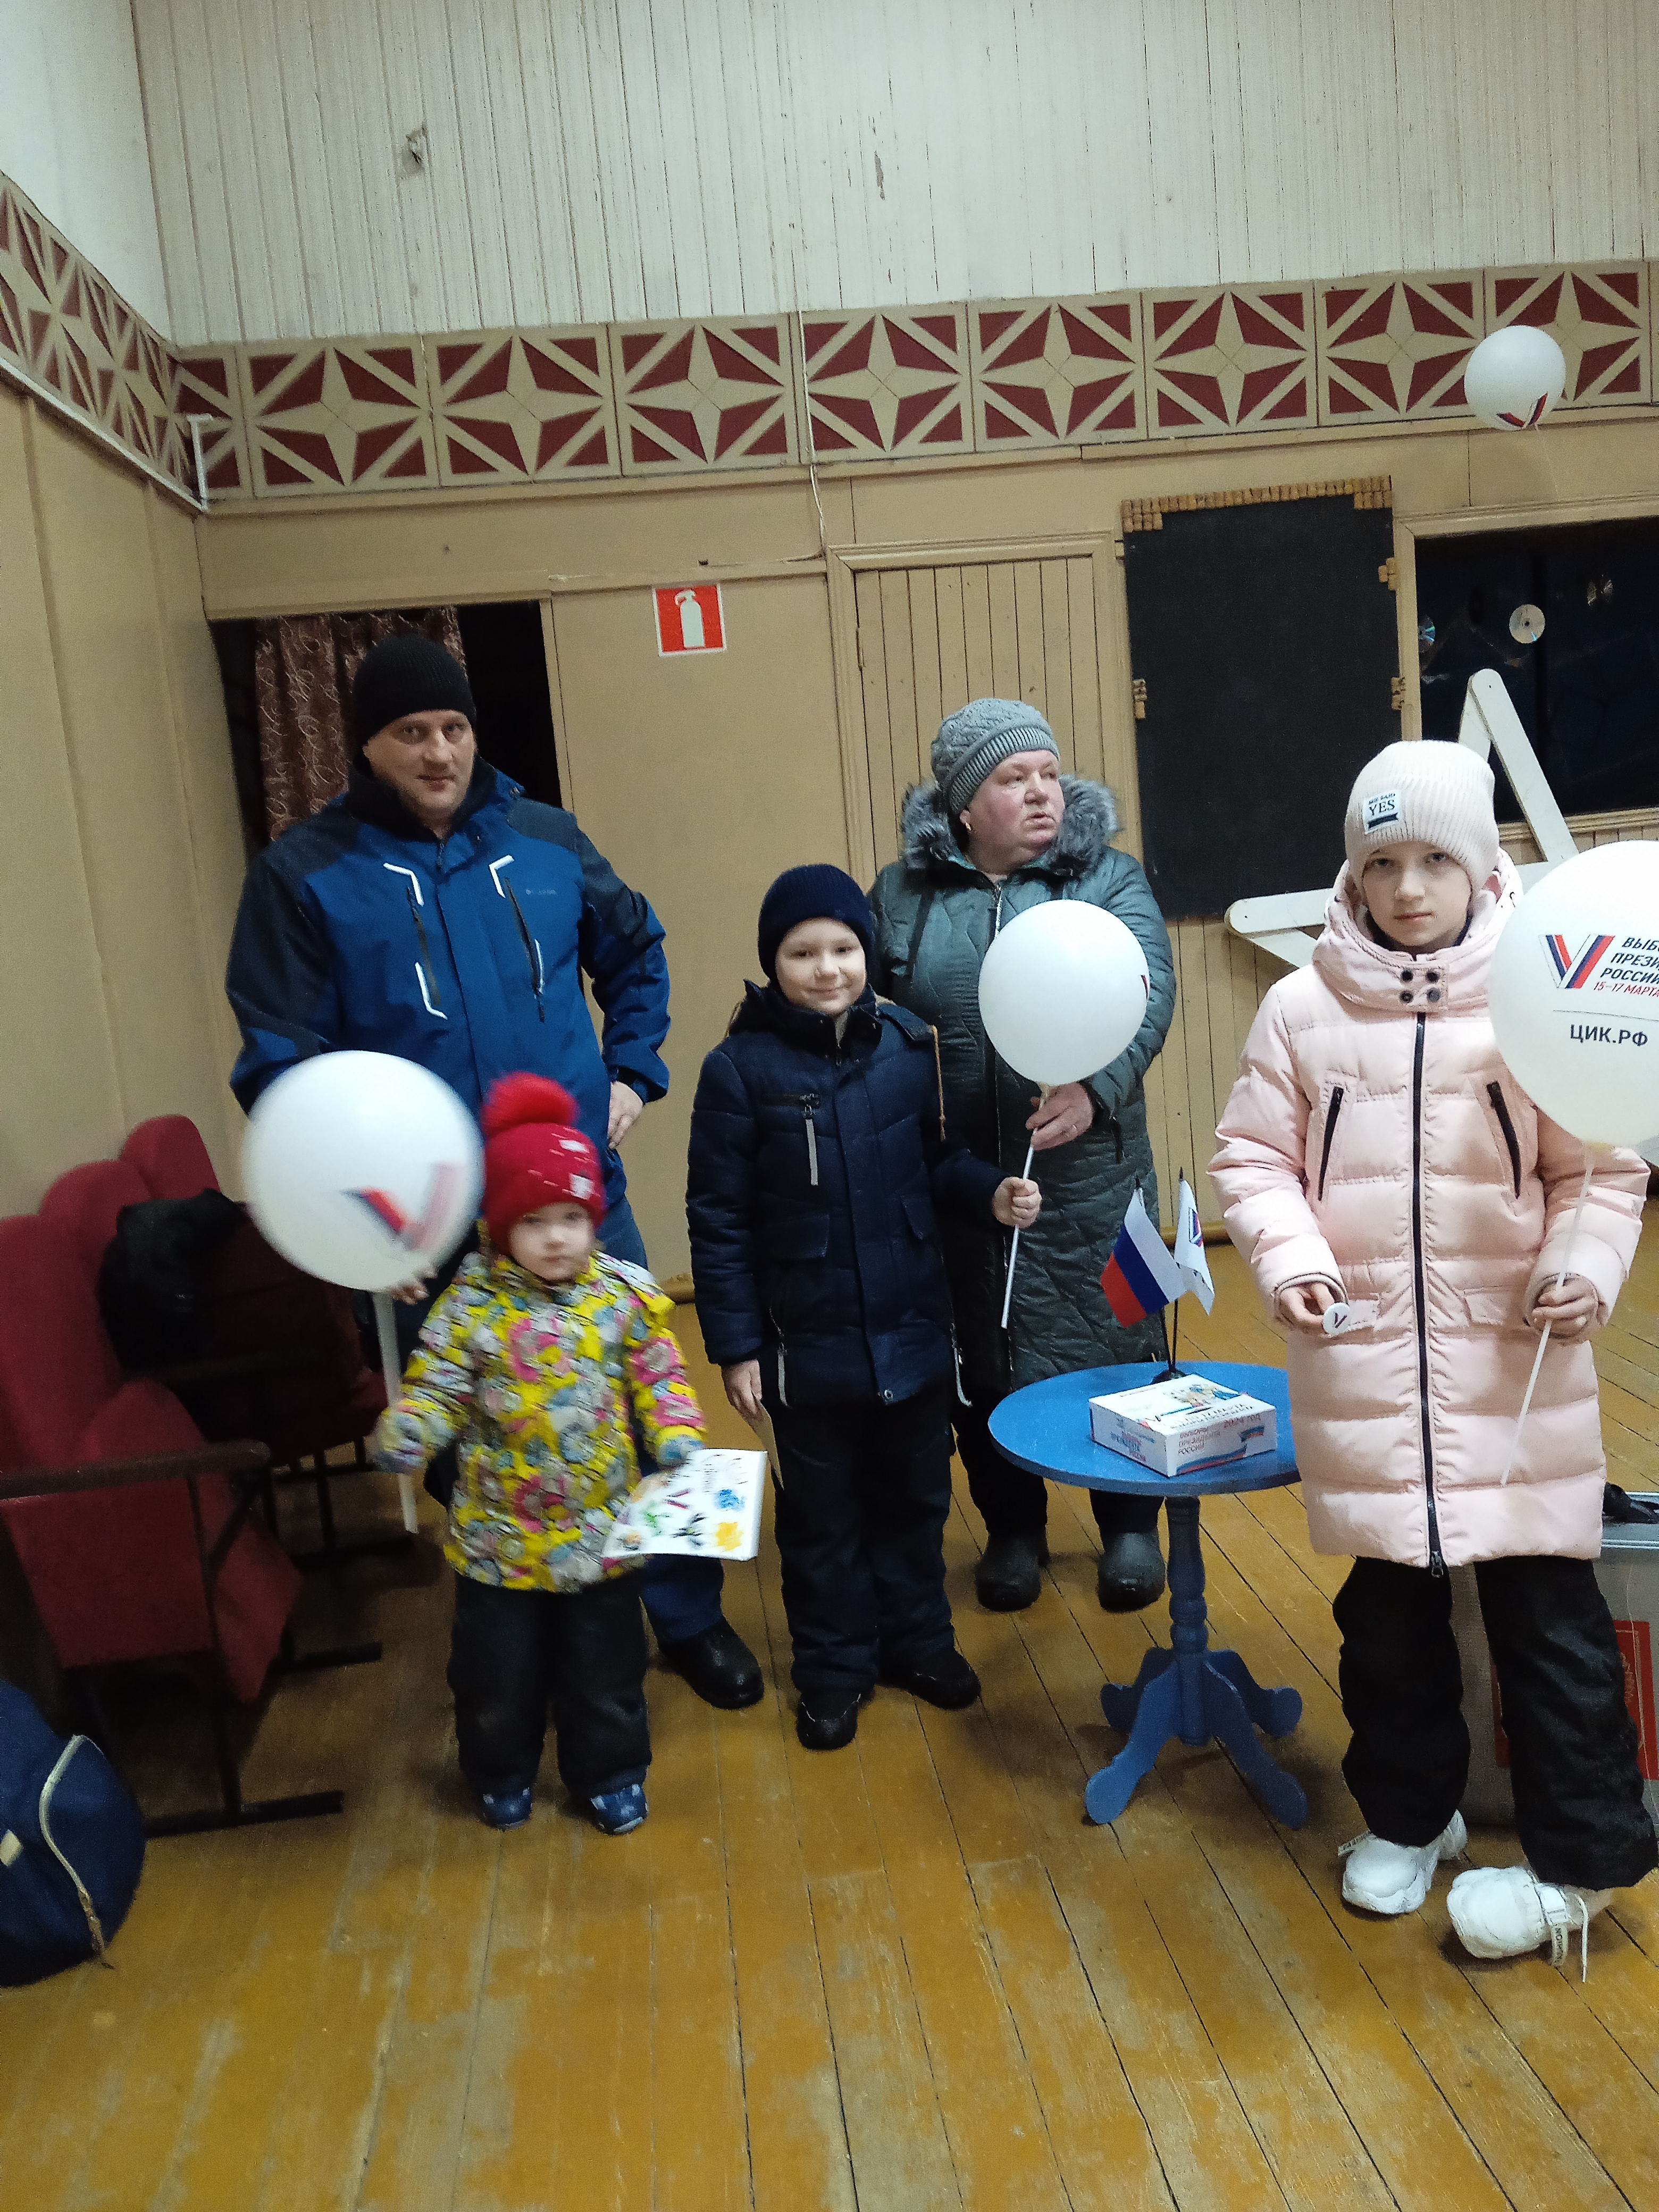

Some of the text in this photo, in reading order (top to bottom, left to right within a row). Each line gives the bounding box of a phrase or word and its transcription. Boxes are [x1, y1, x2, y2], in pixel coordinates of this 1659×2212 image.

[1369, 799, 1395, 816] YES
[1621, 937, 1659, 952] ВЫБ
[1610, 952, 1659, 971] ПРЕЗИ
[1570, 1024, 1648, 1046] ЦИК.РФ
